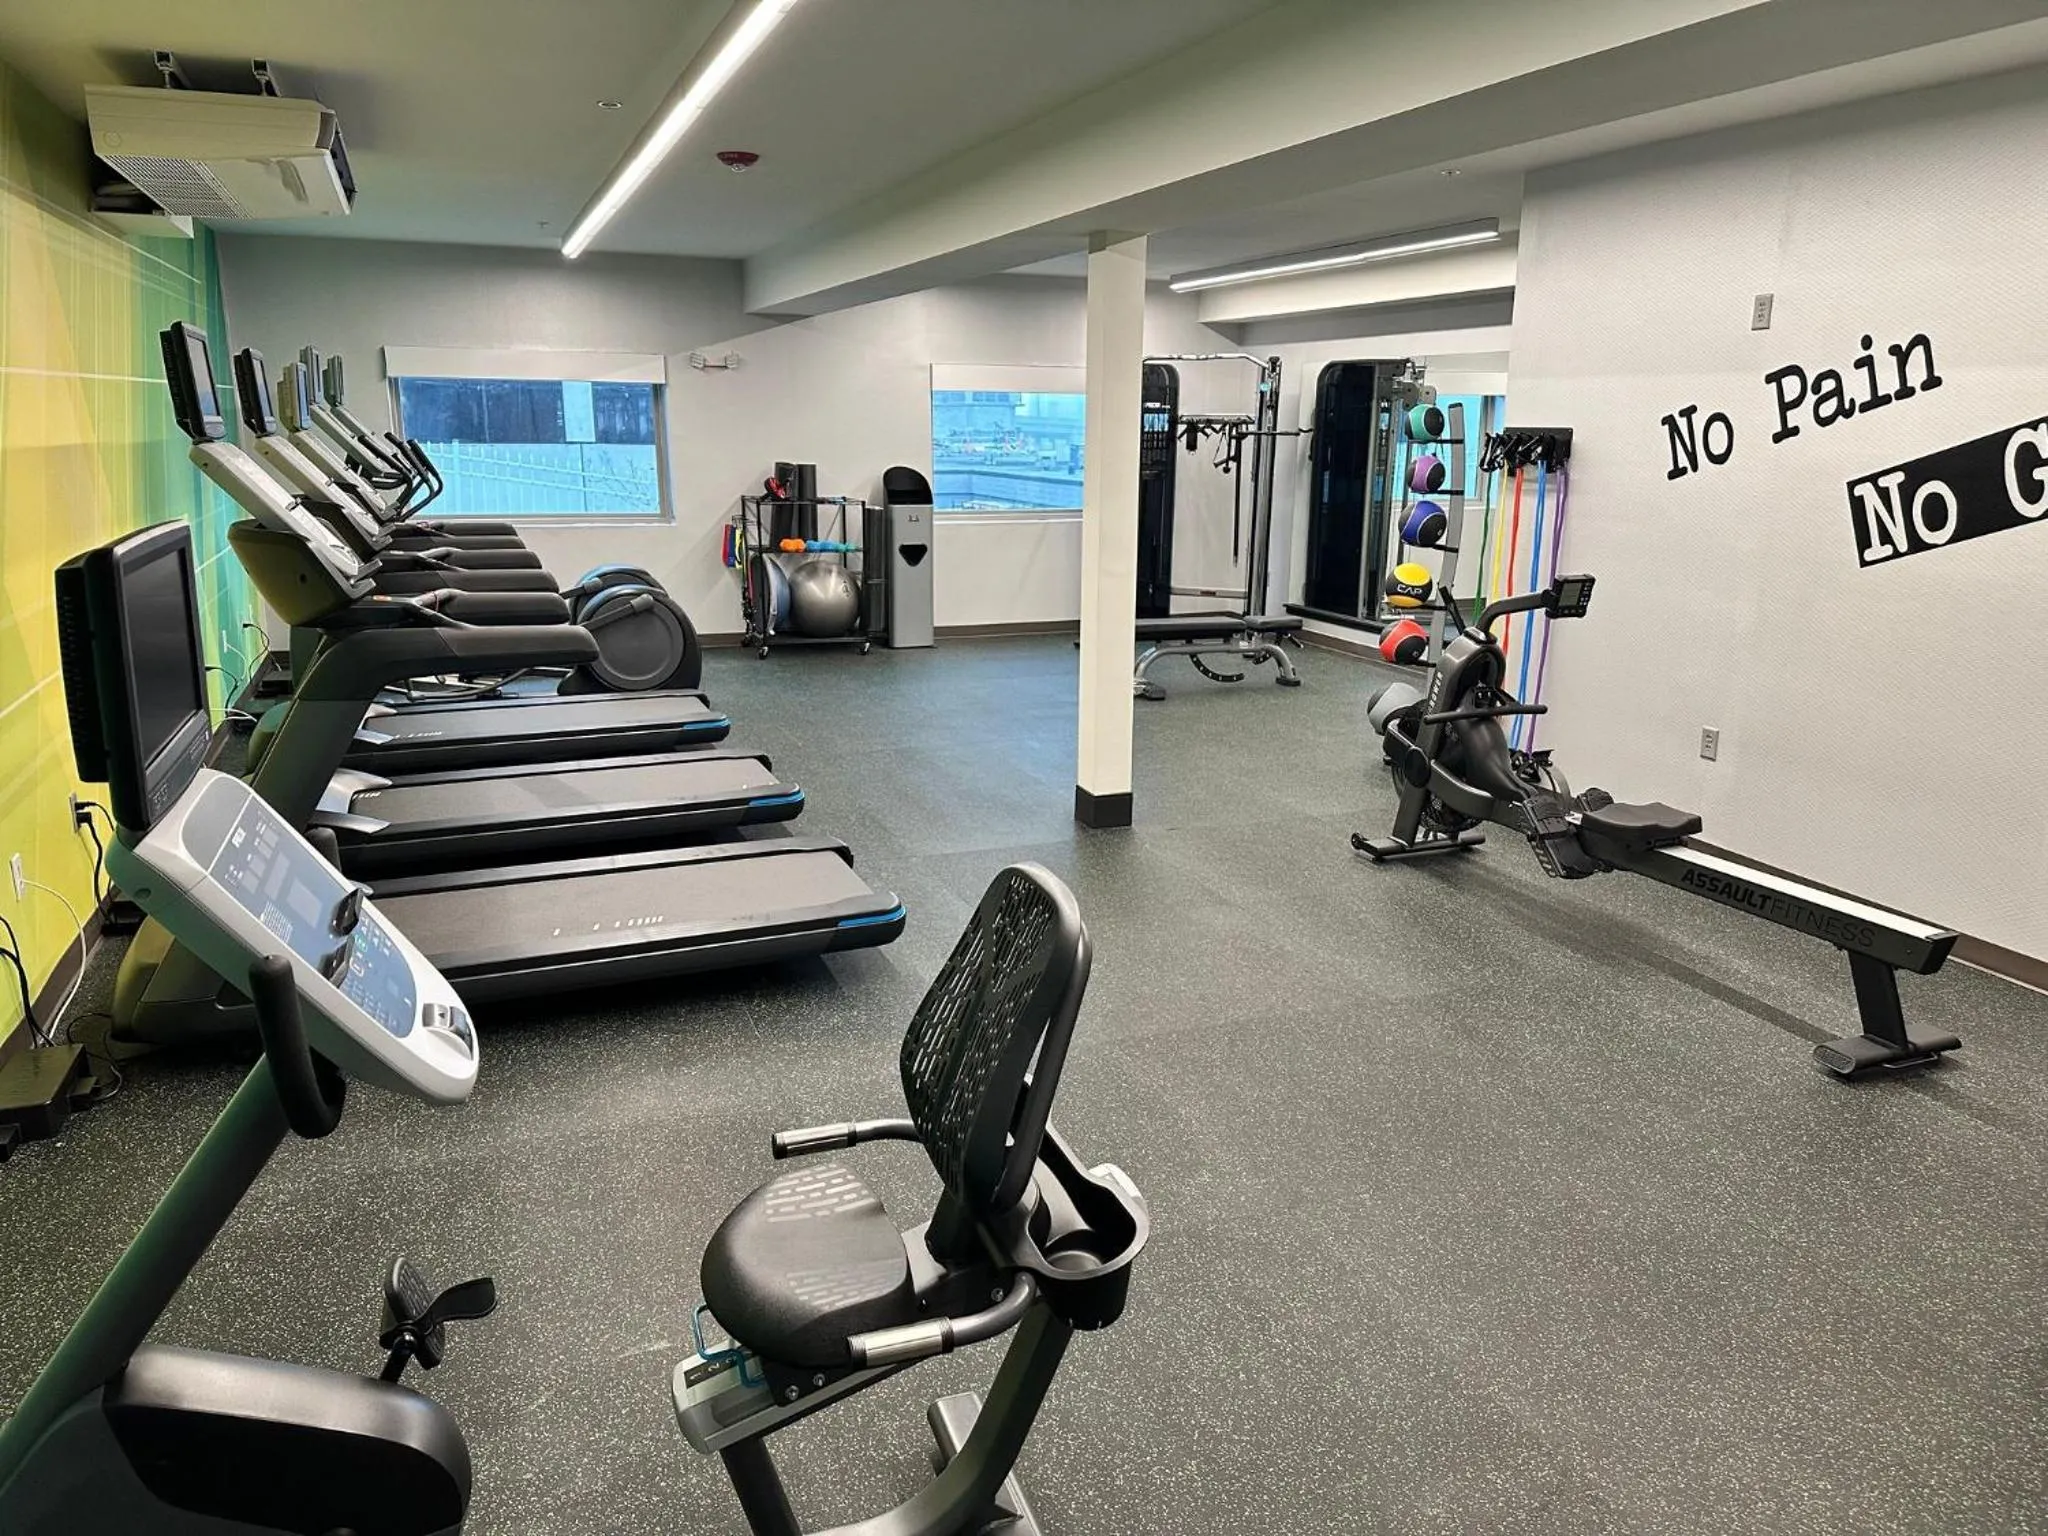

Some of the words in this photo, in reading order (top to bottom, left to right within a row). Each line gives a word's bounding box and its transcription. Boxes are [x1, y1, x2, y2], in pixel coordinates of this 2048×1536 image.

[1661, 404, 1734, 480] No
[1765, 333, 1943, 444] Pain
[1853, 471, 1958, 562] No
[1397, 583, 1423, 594] CAP
